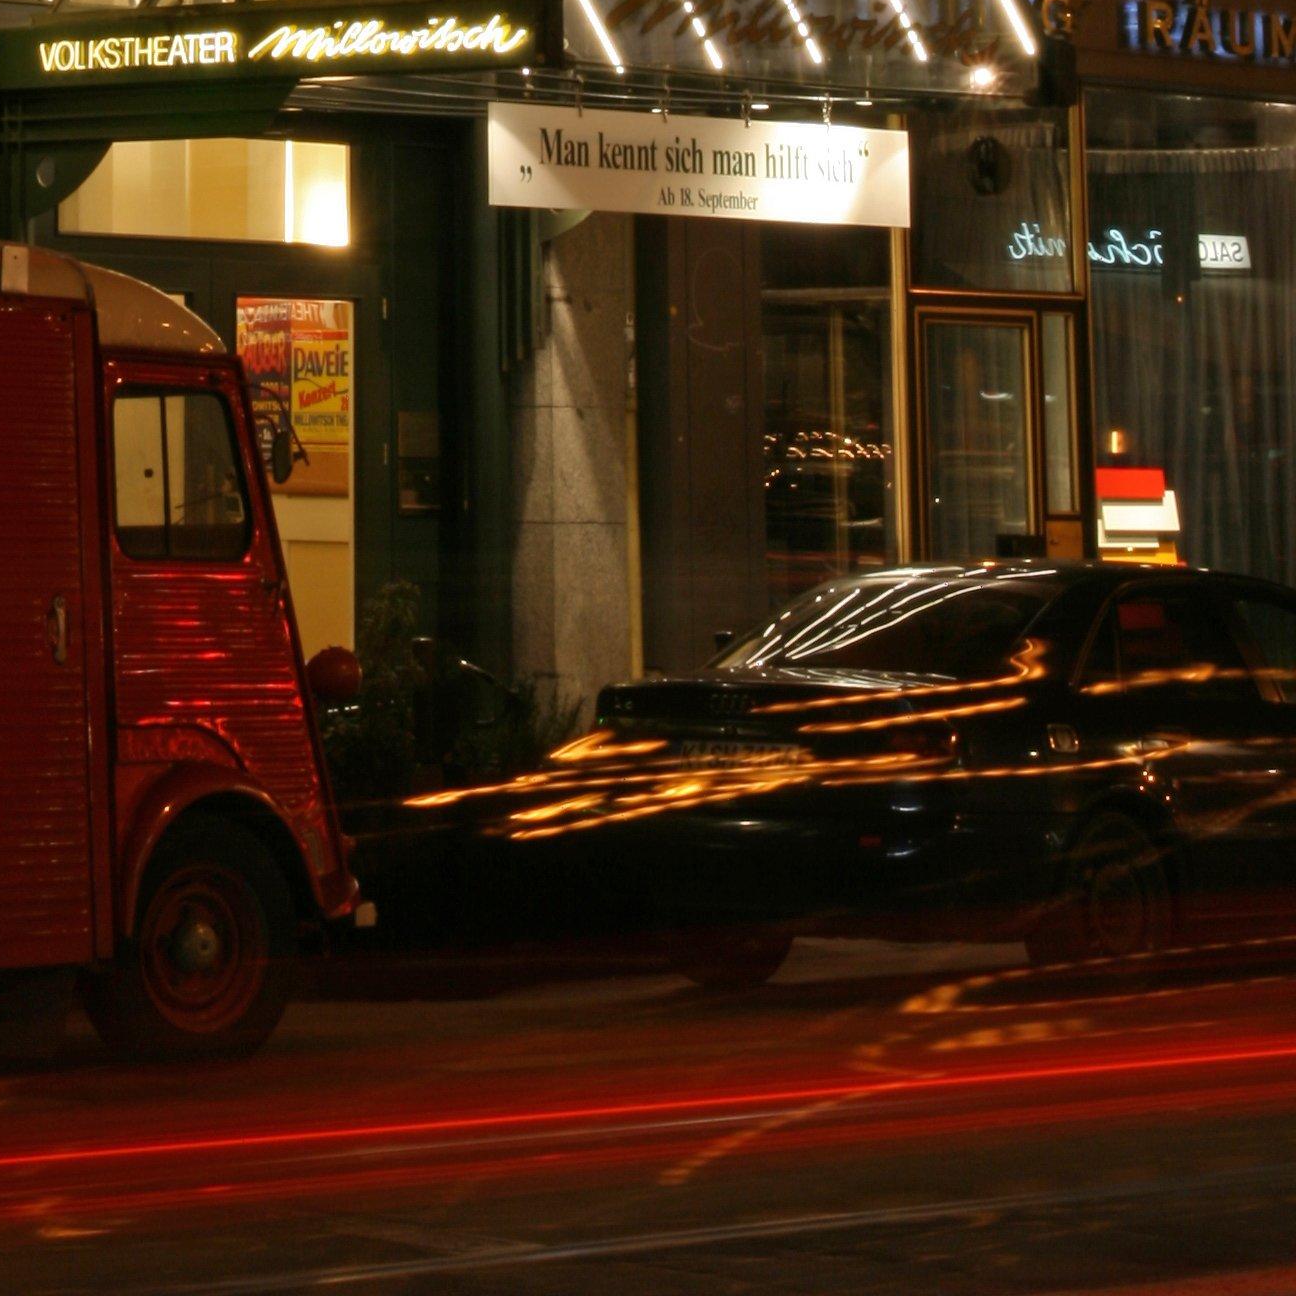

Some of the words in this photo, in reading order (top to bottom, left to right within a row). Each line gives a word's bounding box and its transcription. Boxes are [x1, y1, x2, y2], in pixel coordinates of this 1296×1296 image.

[39, 31, 237, 72] VOLKSTHEATER
[248, 13, 528, 64] Millowitsch
[598, 132, 657, 171] kennt
[665, 136, 703, 175] sich
[712, 148, 757, 177] man
[765, 142, 809, 181] hilft
[657, 188, 675, 206] Ab
[680, 188, 695, 207] 18.
[699, 189, 759, 214] September
